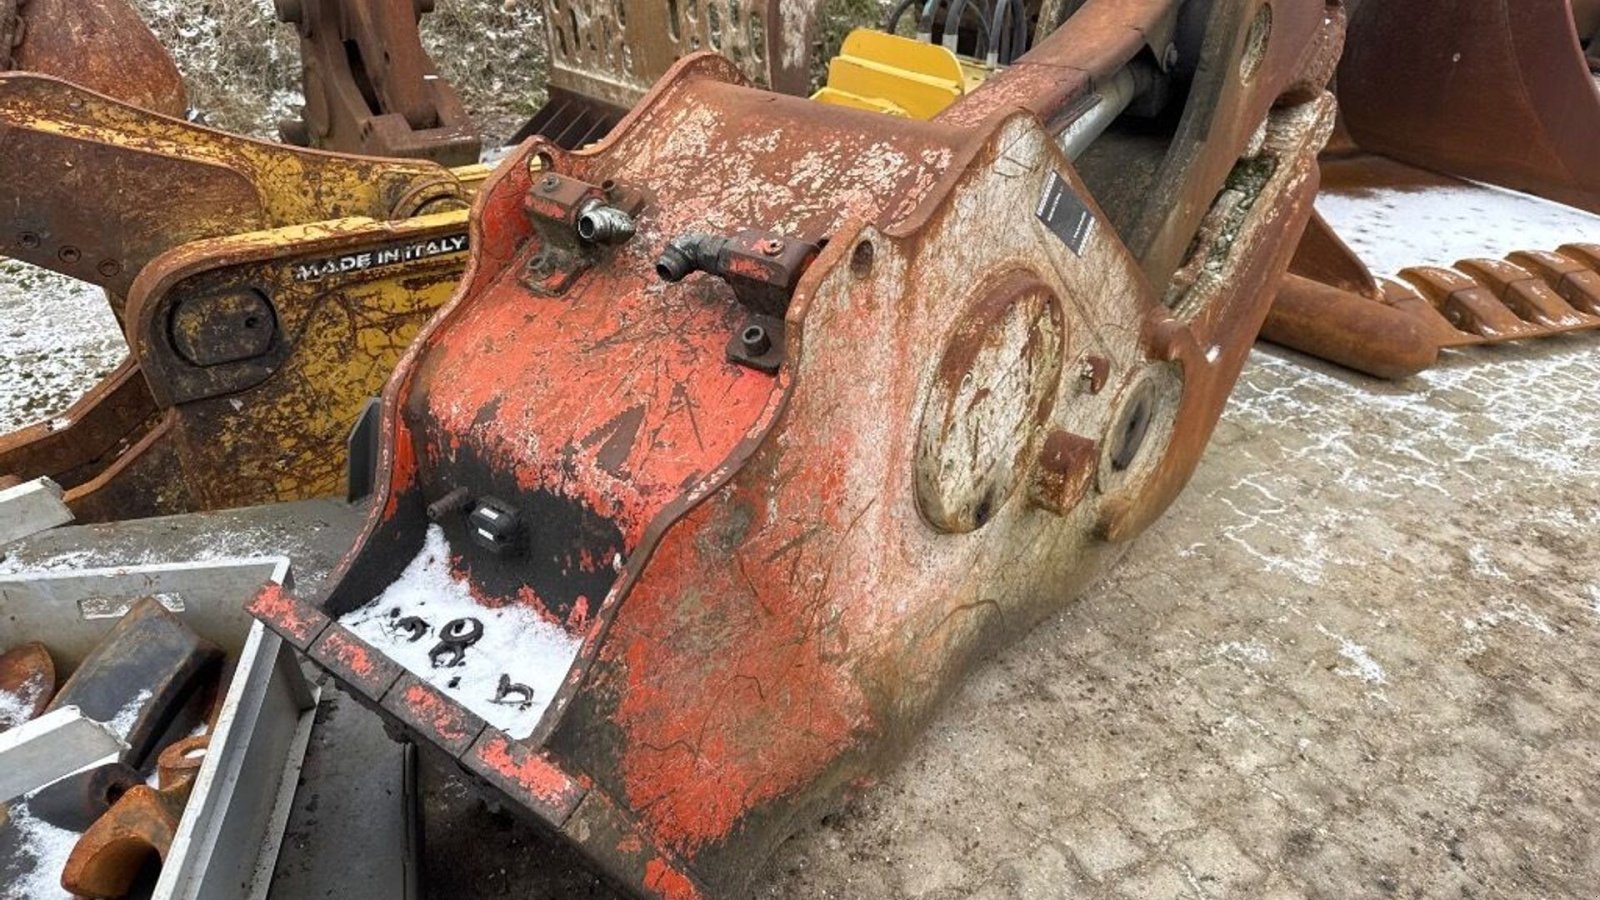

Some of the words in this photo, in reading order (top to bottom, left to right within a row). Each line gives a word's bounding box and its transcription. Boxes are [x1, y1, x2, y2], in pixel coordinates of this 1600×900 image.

[296, 253, 372, 280] MADE
[378, 249, 399, 264] IN
[406, 236, 466, 259] ITALY
